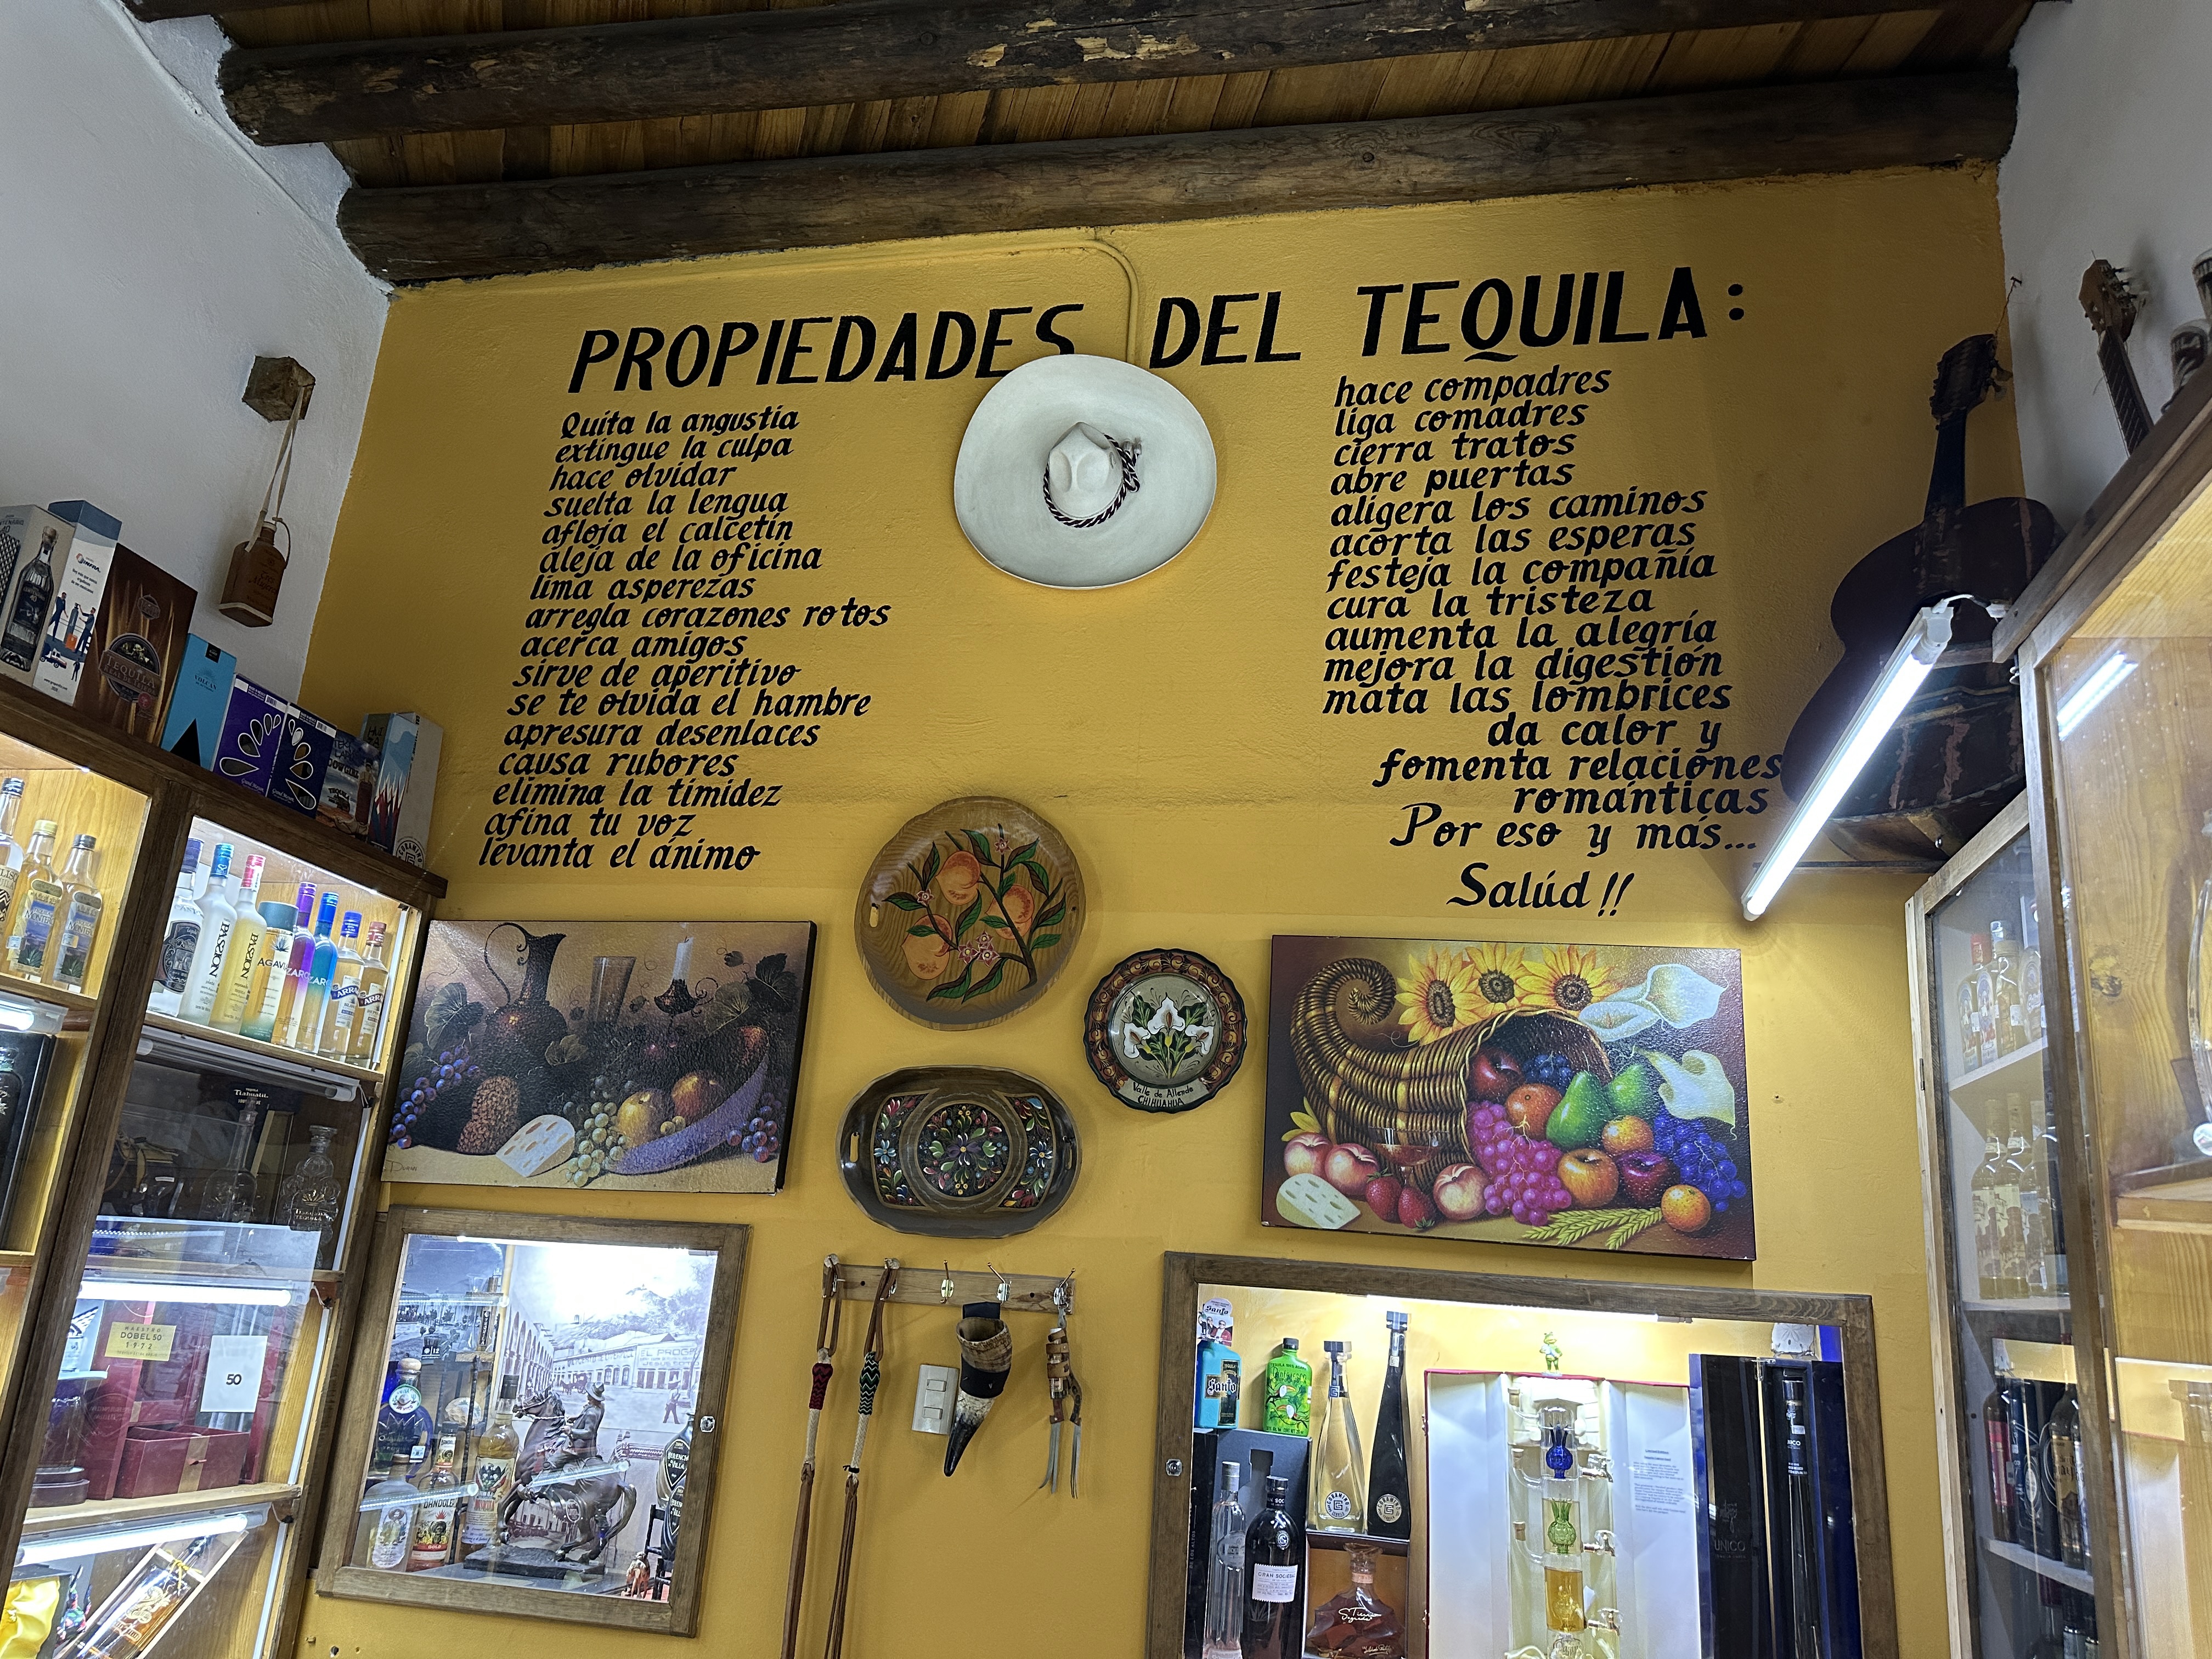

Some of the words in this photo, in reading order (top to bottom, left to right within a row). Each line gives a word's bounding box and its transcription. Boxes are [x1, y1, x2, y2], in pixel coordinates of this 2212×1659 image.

[568, 304, 1084, 393] PROPIEDADES
[1149, 291, 1302, 369] DEL
[1334, 376, 1413, 407] hace
[1425, 364, 1612, 407] compadres
[561, 410, 635, 439] Quita
[646, 411, 672, 433] la
[681, 405, 799, 436] angustia
[1335, 407, 1397, 439] liga
[1415, 399, 1589, 432] comadres
[555, 438, 669, 467] extingue
[681, 435, 707, 459] la
[718, 433, 794, 462] culpa
[1334, 438, 1435, 466] cierra
[1452, 429, 1577, 460] tratos
[549, 465, 614, 491] hace
[625, 461, 737, 488] olvidar
[1330, 466, 1407, 495] abre
[1424, 459, 1576, 498] puertas
[544, 491, 633, 517] suelta
[647, 489, 676, 515] la
[688, 488, 788, 520] lengua
[1331, 495, 1455, 532] aligera
[1471, 491, 1531, 522] los
[1549, 486, 1707, 520] caminos
[542, 518, 627, 550] afloja
[642, 517, 669, 543] el
[1330, 526, 1453, 557] acorta
[1475, 524, 1532, 554] las
[1549, 523, 1696, 556] esperas
[540, 546, 614, 578] aleja
[626, 545, 660, 571] de
[672, 544, 702, 571] la
[710, 542, 822, 577] oficina
[1326, 557, 1452, 594] festeja
[1471, 557, 1508, 585] la
[530, 574, 593, 600] lima
[608, 578, 756, 604] asperezas
[1328, 596, 1411, 619] cura
[1432, 588, 1470, 617] la
[1486, 585, 1655, 616] tristeza
[526, 602, 630, 635] arregla
[642, 607, 791, 628] corazones
[803, 597, 891, 627] rotos
[521, 636, 619, 657] acerca
[631, 631, 748, 664] amigos
[1325, 618, 1498, 651] aumenta
[1517, 617, 1558, 648] la
[106, 656, 156, 689] TEQUILA
[512, 659, 592, 687] sirve
[600, 657, 639, 687] de
[651, 658, 802, 693] aperitivo
[1324, 657, 1455, 687] mejora
[1475, 650, 1515, 681] la
[507, 694, 545, 715] se
[558, 688, 587, 716] te
[598, 688, 701, 715] olvida
[712, 687, 741, 716] el
[753, 687, 871, 717] hambre
[1323, 682, 1428, 714] mata
[1450, 682, 1512, 713] las
[1532, 678, 1733, 712] lombrices
[504, 724, 643, 750] apresura
[656, 719, 820, 746] desenlaces
[1488, 712, 1542, 747] da
[1562, 713, 1677, 746] calor
[1695, 720, 1722, 753] y
[499, 753, 591, 775] causa
[606, 748, 739, 777] rubores
[1372, 748, 1551, 787] fomenta
[1569, 748, 1783, 783] relaciones
[493, 777, 606, 806] elimina
[619, 778, 653, 806] la
[668, 778, 783, 808] timidez
[484, 807, 572, 841] afina
[590, 808, 622, 836] tu
[637, 814, 696, 837] voz
[1390, 803, 1482, 847] Por
[1497, 822, 1562, 847] eso
[1587, 823, 1611, 857] y
[479, 837, 594, 868] levanta
[610, 838, 640, 867] el
[1133, 1081, 1150, 1097] Valle
[1154, 1088, 1163, 1098] de
[1137, 1095, 1185, 1108] CHIHUAHUA
[120, 1332, 152, 1341] DOBEL
[226, 1374, 242, 1386] 50
[1207, 1377, 1237, 1396] Santo
[1326, 1492, 1350, 1505] CORAMINO
[1377, 1496, 1401, 1510] CORAMINO
